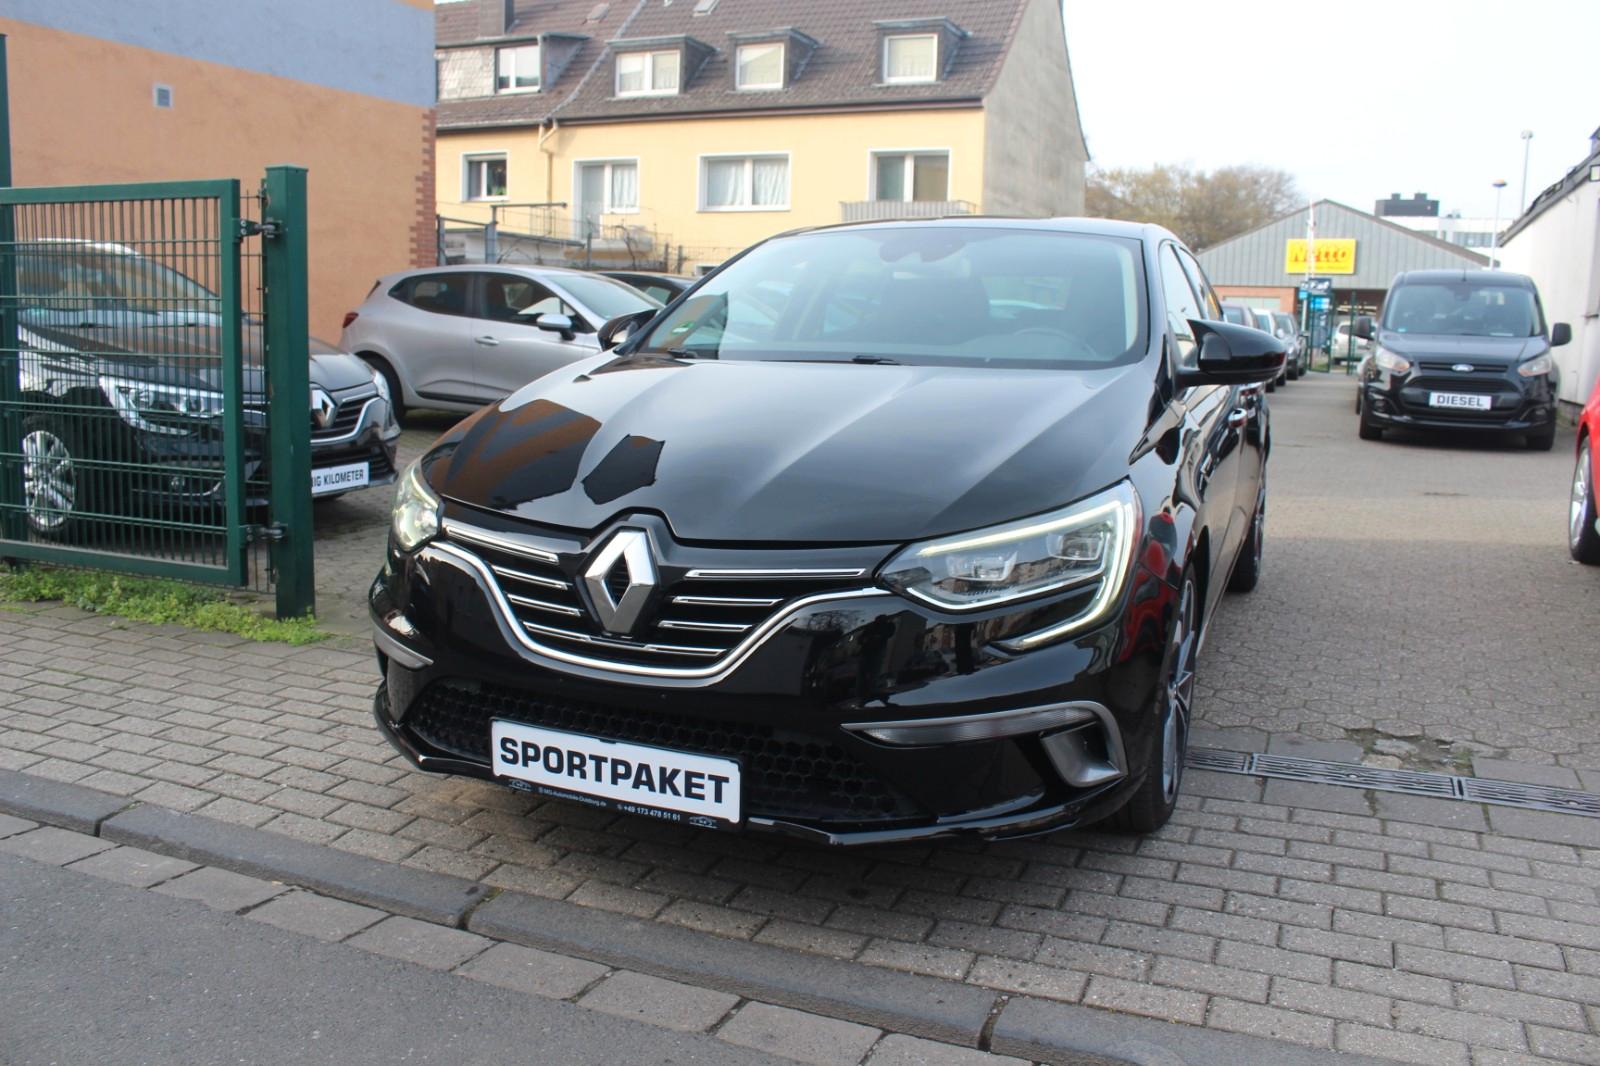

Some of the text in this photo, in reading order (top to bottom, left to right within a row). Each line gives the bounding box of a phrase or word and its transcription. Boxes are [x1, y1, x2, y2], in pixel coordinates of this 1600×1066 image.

[1436, 394, 1483, 407] DIESEL
[323, 469, 364, 485] KILOMETER
[500, 737, 730, 803] SPORTPAKET
[637, 807, 648, 815] 173
[650, 810, 661, 818] 478
